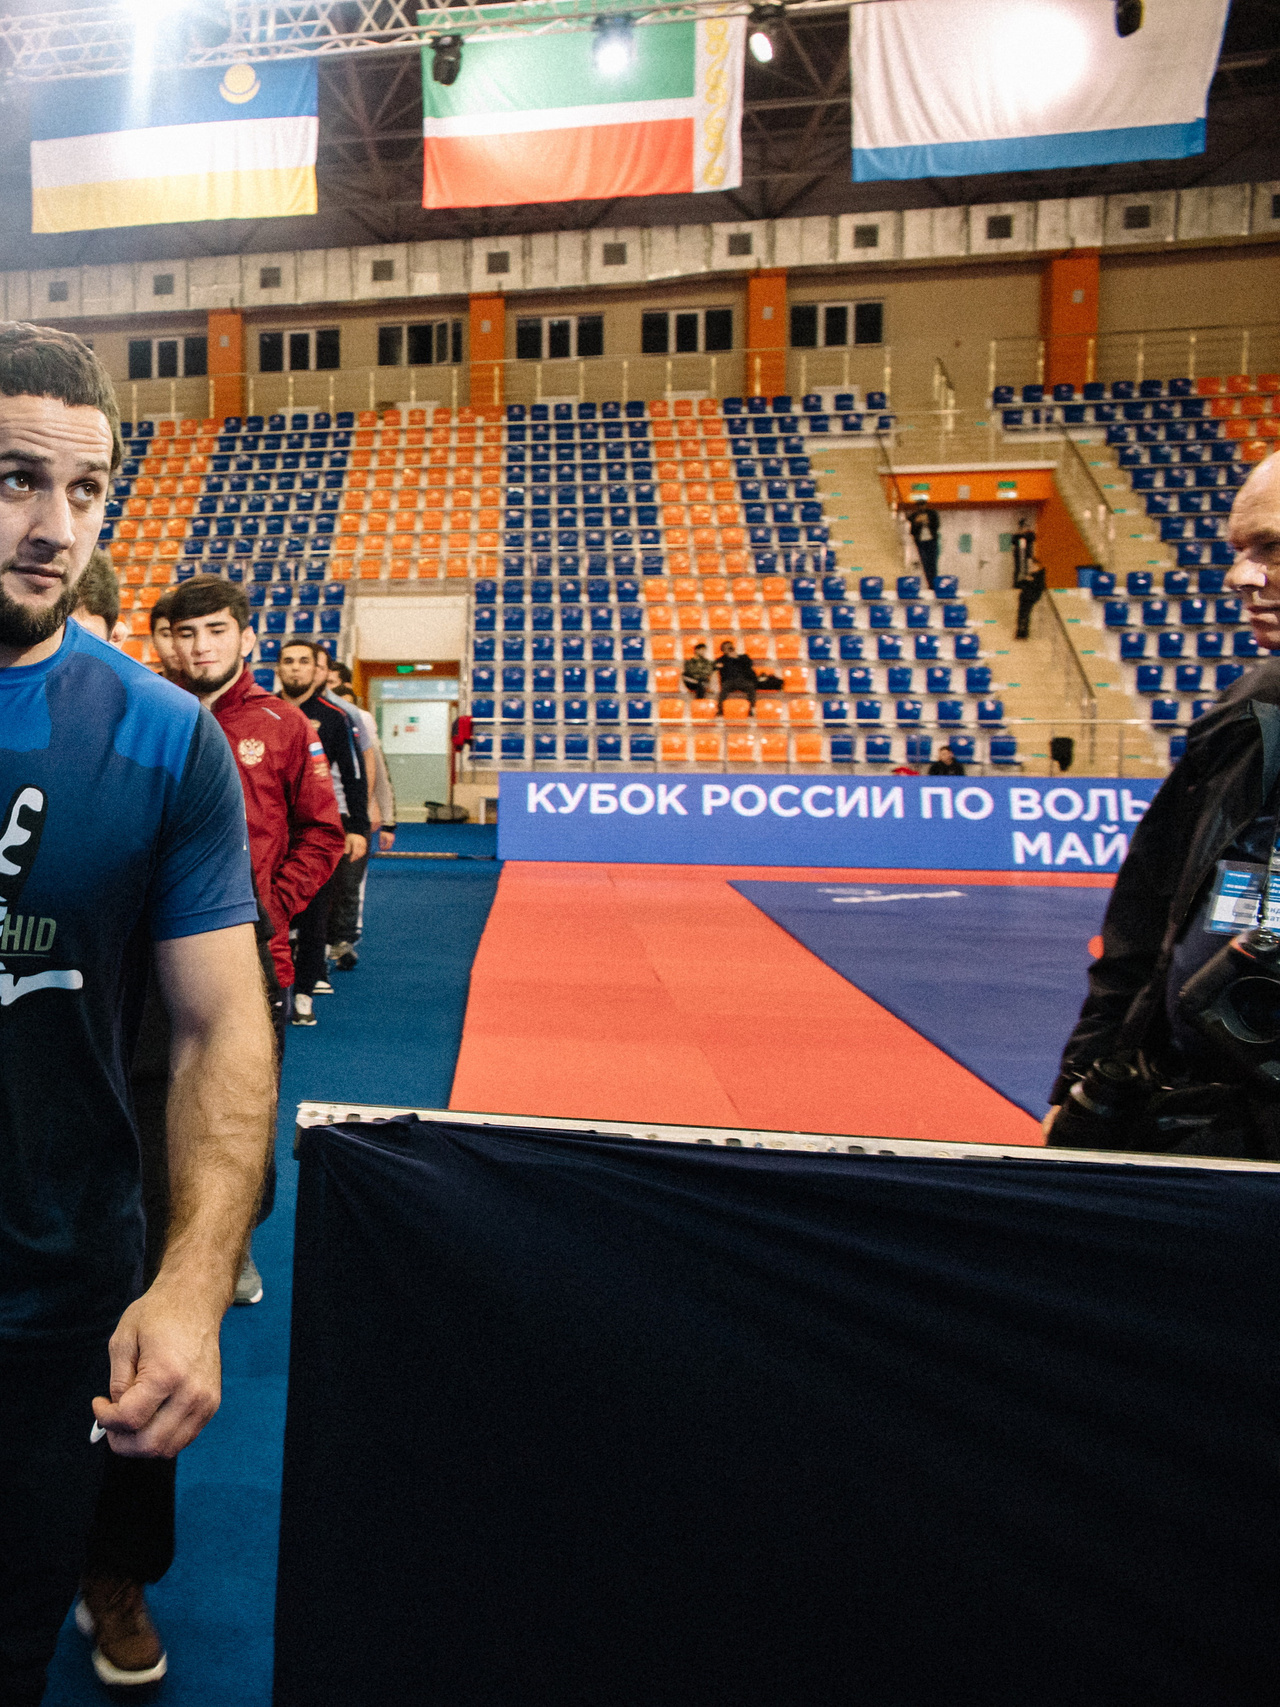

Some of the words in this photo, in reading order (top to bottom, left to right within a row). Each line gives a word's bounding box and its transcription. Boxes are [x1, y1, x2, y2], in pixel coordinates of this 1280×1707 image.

[526, 782, 689, 816] КУБОК
[702, 784, 905, 818] РОССИИ
[920, 787, 995, 820] ПО
[1009, 787, 1158, 822] ВОЛЬ
[1012, 824, 1130, 866] МАЙ
